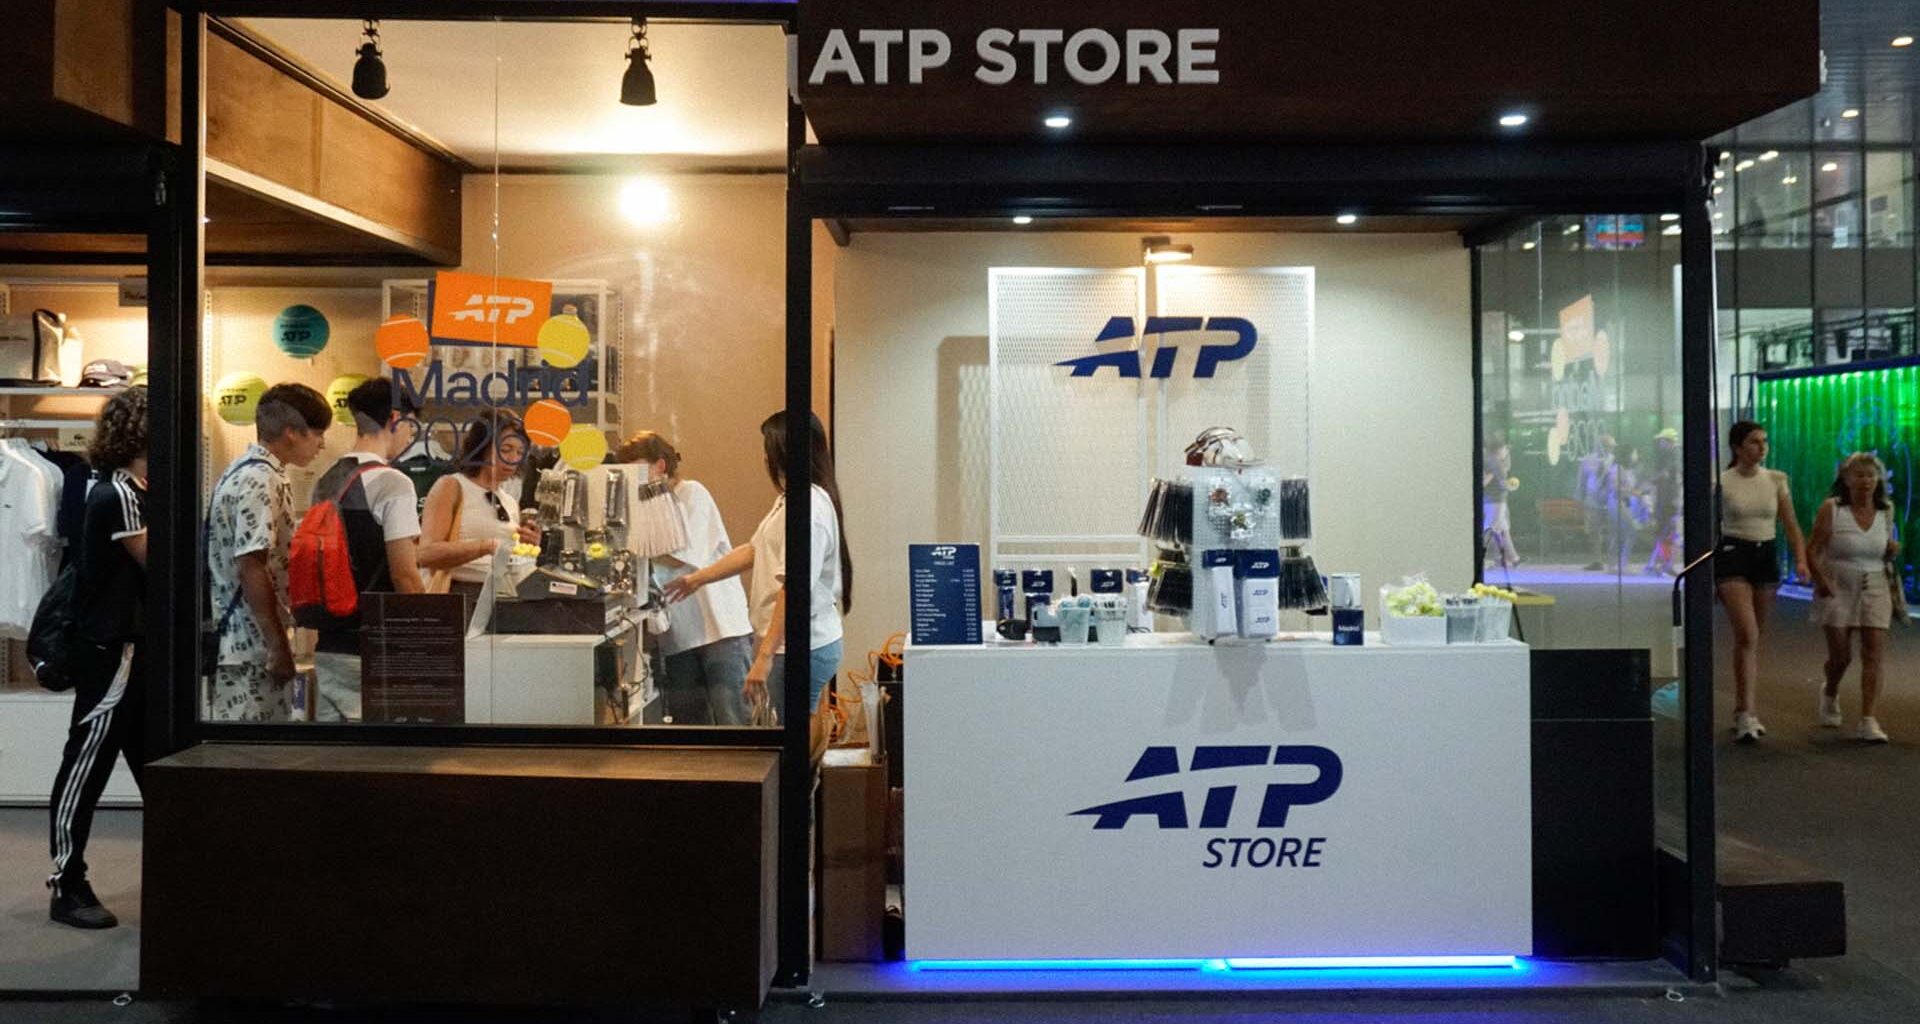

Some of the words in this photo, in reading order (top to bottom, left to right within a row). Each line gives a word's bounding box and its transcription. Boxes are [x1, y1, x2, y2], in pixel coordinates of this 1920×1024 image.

[808, 28, 952, 85] ATP
[974, 27, 1220, 85] STORE
[448, 293, 535, 325] ATP
[1051, 316, 1258, 378] ATP
[218, 394, 247, 406] ATP
[392, 360, 588, 408] Madrid
[930, 546, 957, 556] ATP
[1065, 744, 1344, 830] ATP
[1202, 837, 1327, 868] STORE
